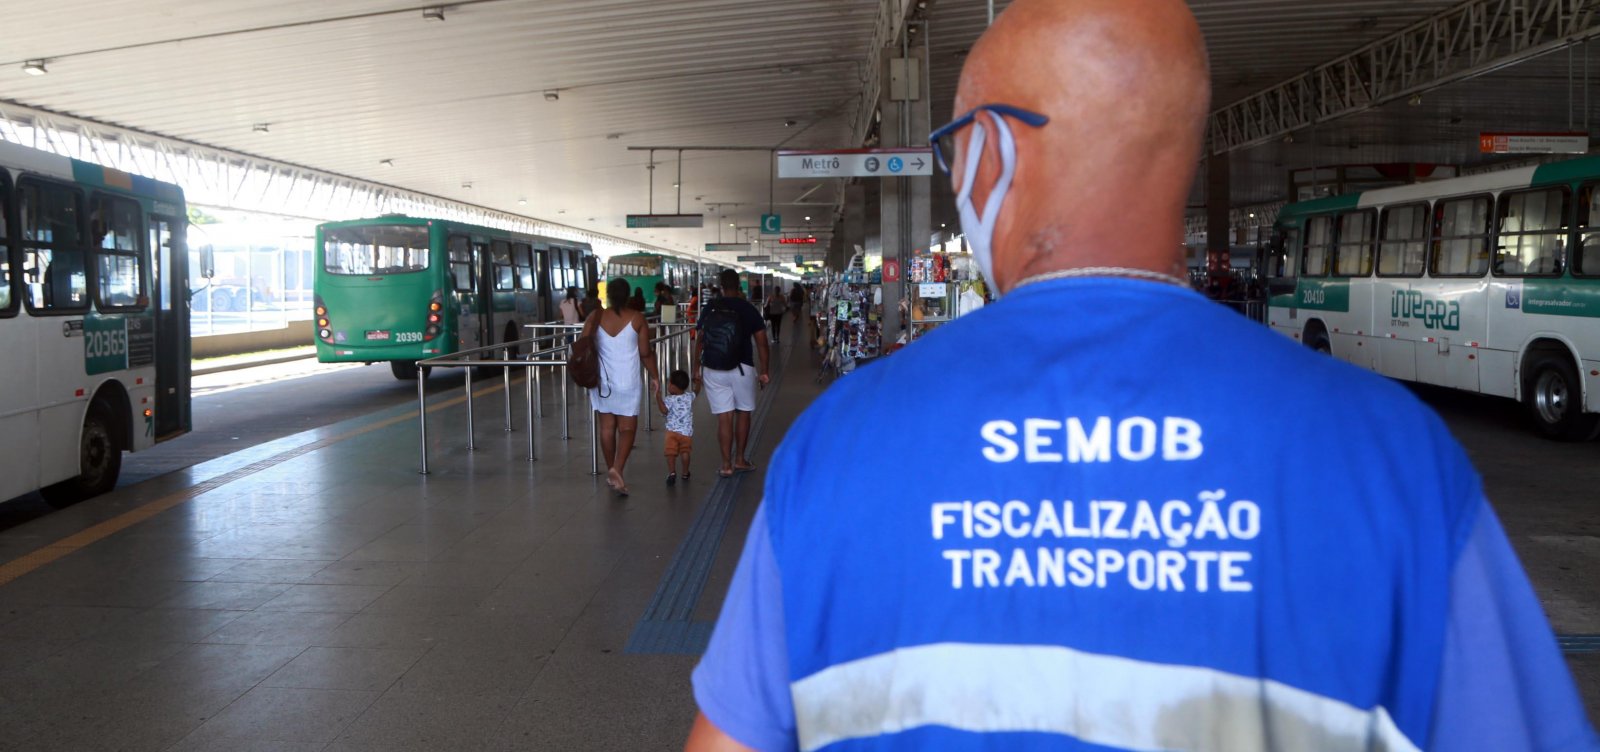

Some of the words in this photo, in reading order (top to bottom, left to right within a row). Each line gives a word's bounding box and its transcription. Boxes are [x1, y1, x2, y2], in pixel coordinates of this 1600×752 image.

[801, 157, 840, 170] Metrô
[765, 216, 776, 231] C
[1303, 290, 1325, 304] 20410
[86, 330, 126, 358] 20365
[395, 331, 423, 343] 20390
[980, 416, 1204, 463] SEMOB
[931, 489, 1261, 547] FISCALIZAÇÃO
[942, 547, 1253, 592] TRANSPORTE
